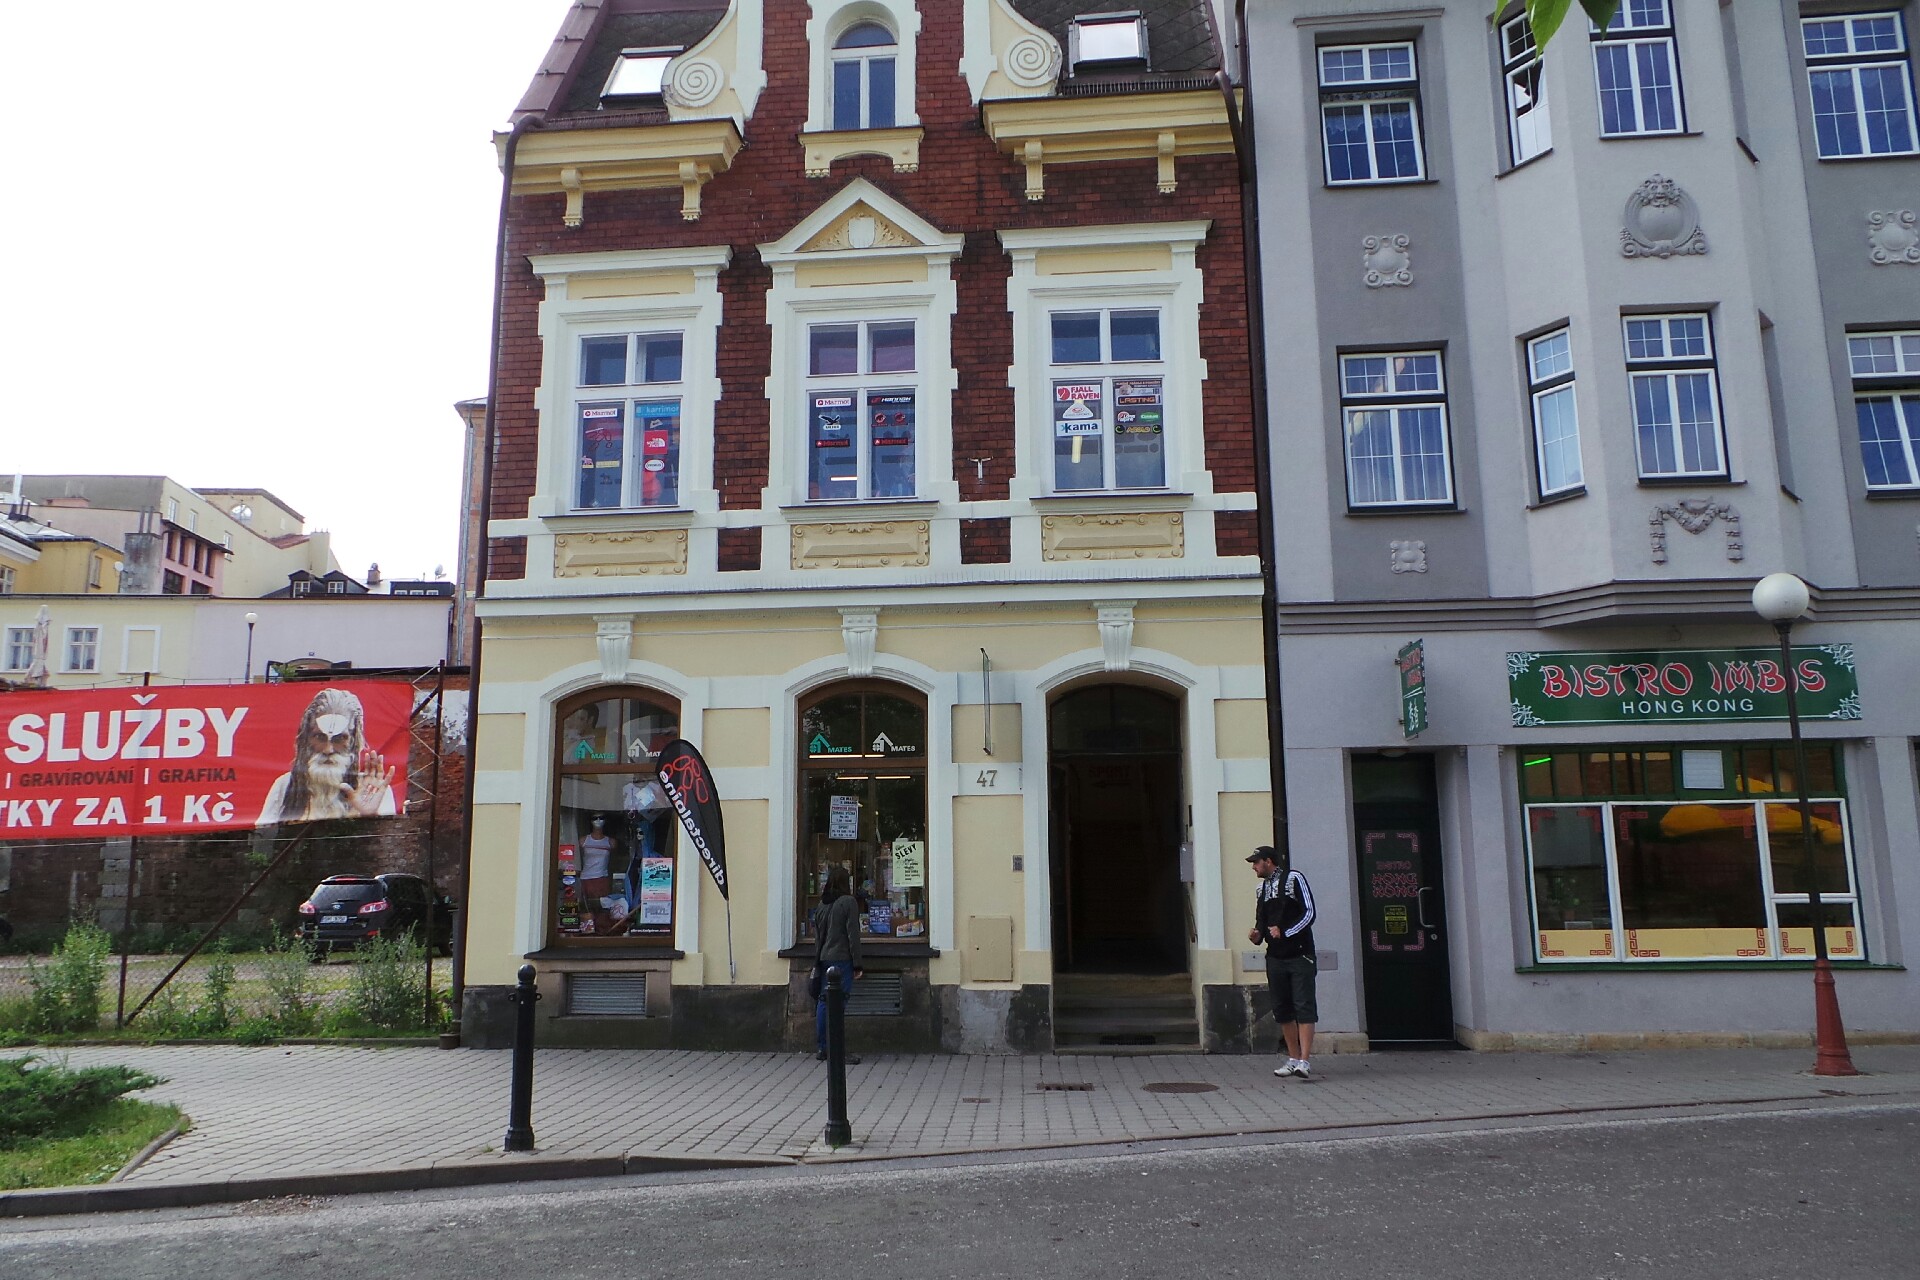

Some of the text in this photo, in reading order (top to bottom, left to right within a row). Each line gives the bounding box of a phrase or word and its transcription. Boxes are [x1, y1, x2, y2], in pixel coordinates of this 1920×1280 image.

[646, 405, 679, 414] karrimor
[1065, 423, 1098, 433] kama
[1540, 662, 1693, 698] BISTRO
[1623, 698, 1754, 715] HONG KONG
[4, 693, 249, 764] SLUŽBY
[20, 766, 237, 787] GRAVÍROVÁNÍ GRAFIKA
[976, 769, 998, 788] 47
[0, 792, 235, 828] KY ZA 1 Kč
[895, 843, 916, 860] SLEVY
